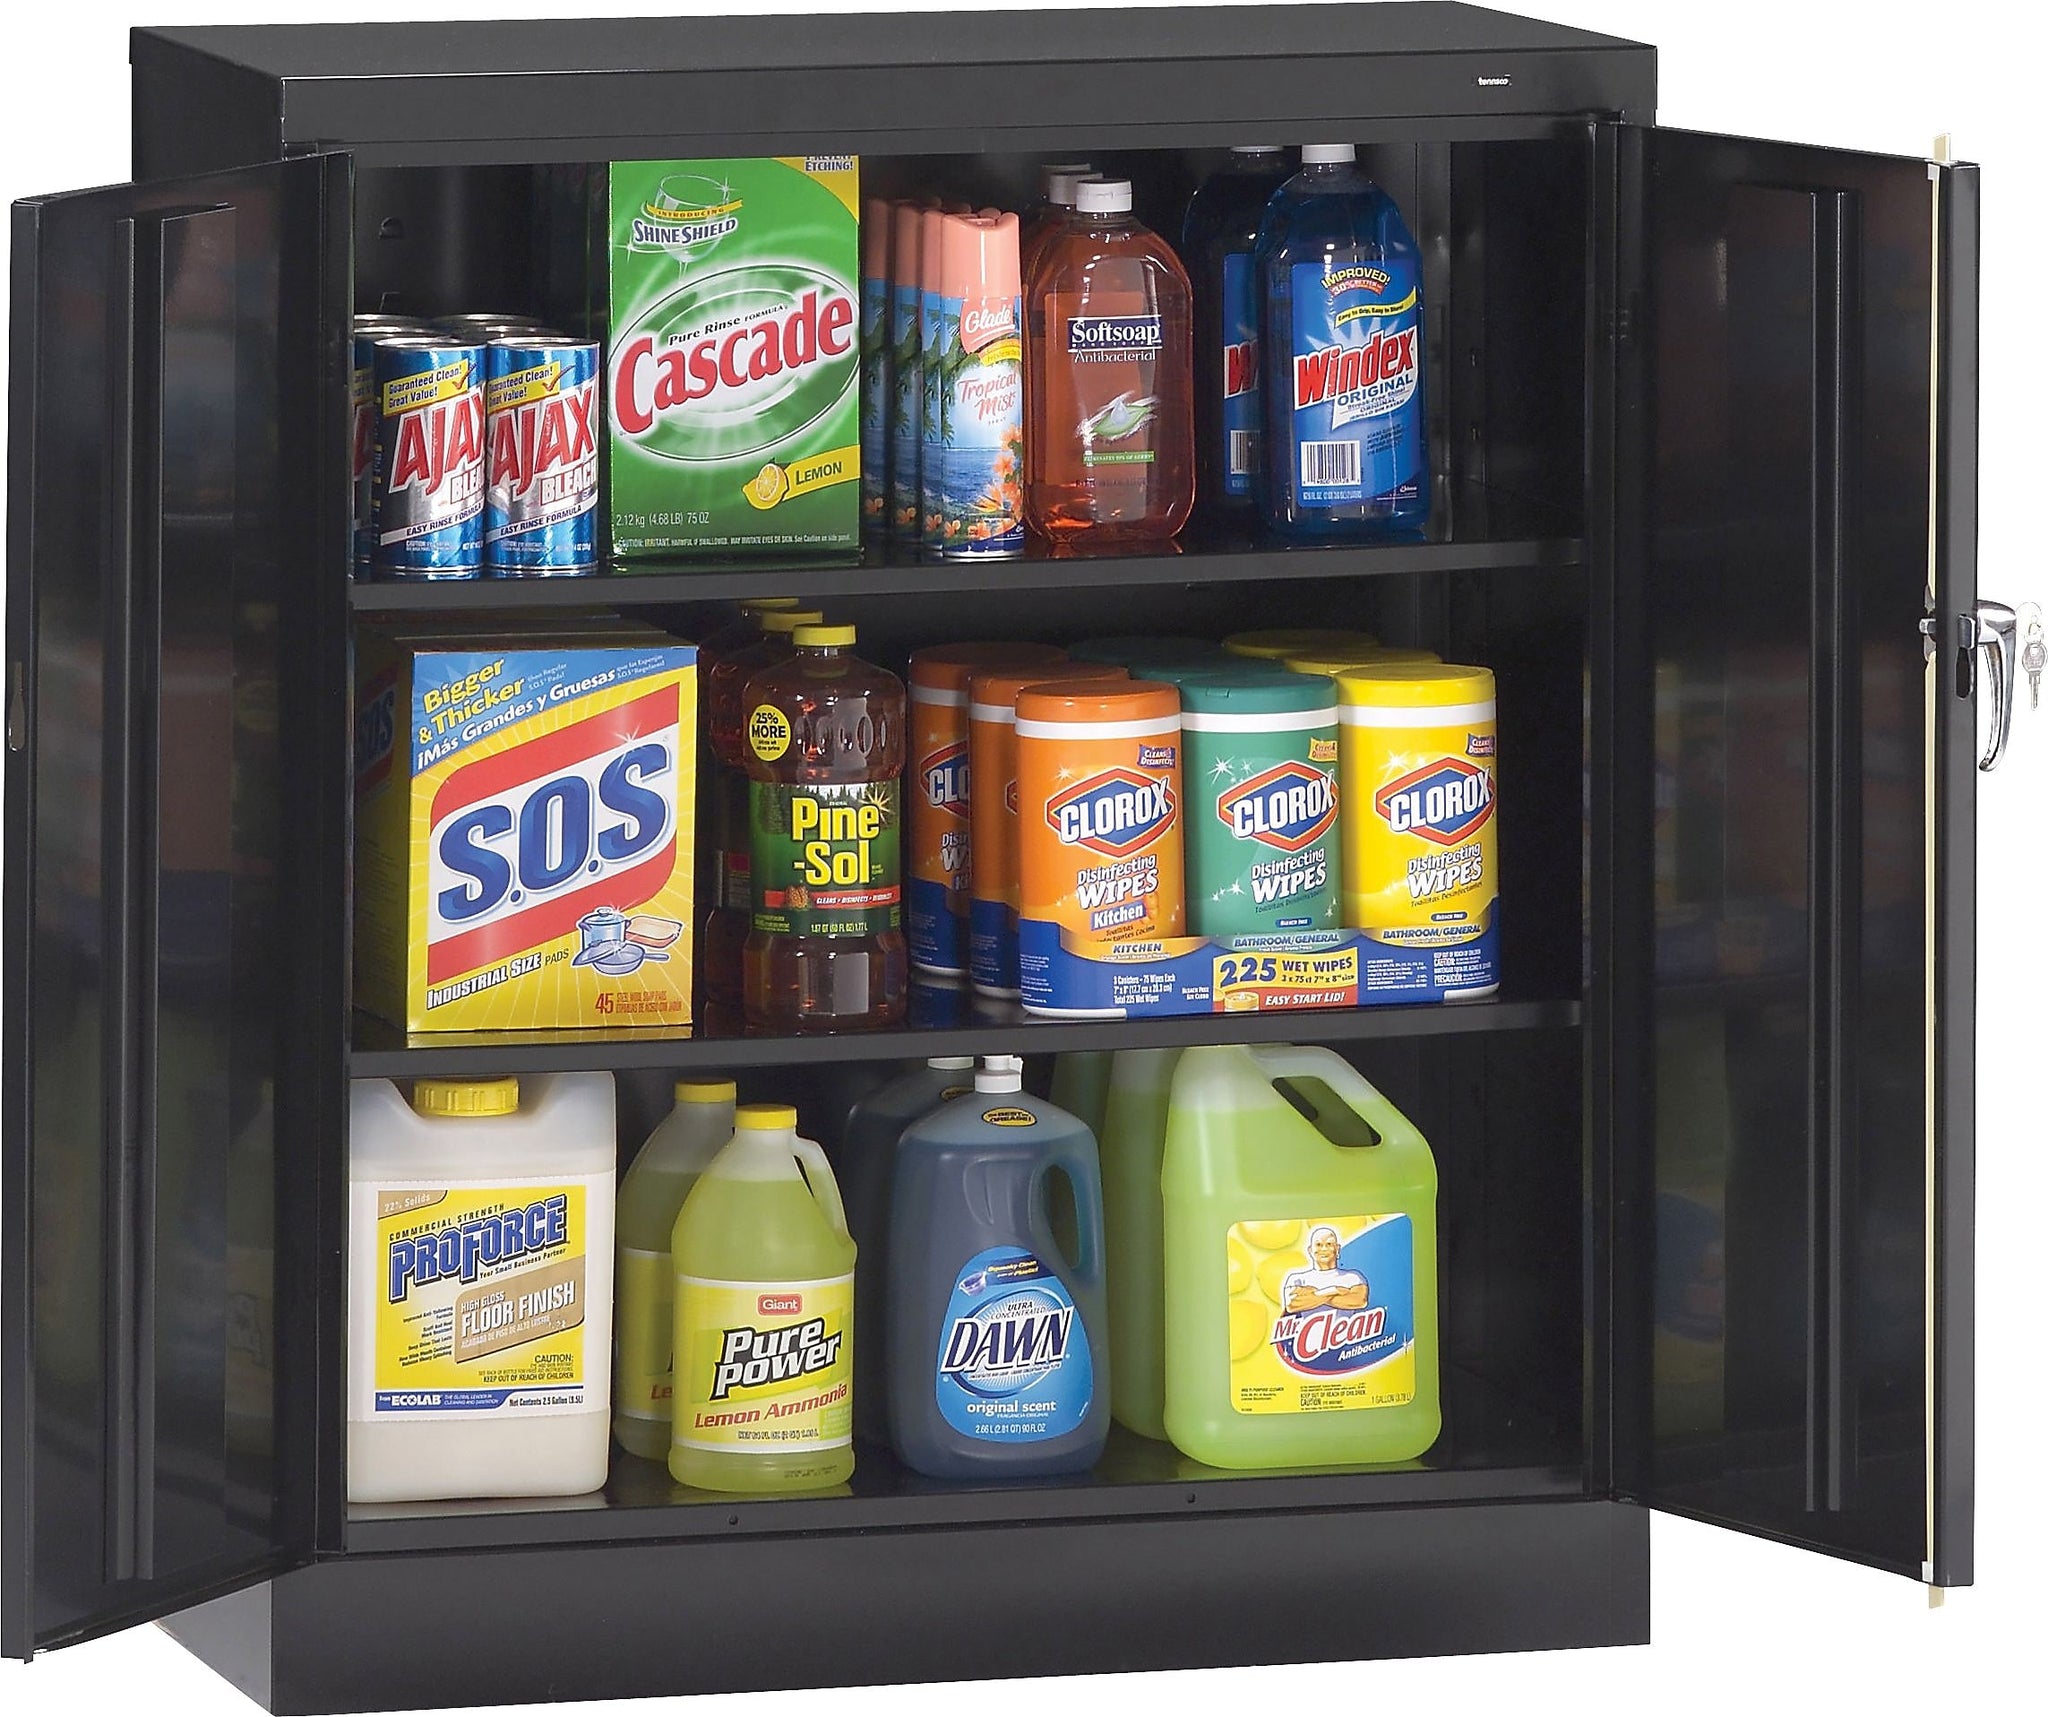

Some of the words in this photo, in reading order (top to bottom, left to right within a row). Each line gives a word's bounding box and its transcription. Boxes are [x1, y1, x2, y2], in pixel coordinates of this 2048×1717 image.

[805, 160, 854, 172] ETCHING!
[657, 206, 726, 218] INTRODUCING
[1321, 267, 1391, 288] IMPROVED!
[669, 329, 701, 346] Pure
[704, 315, 741, 335] Rinse
[744, 305, 785, 323] FORMULA
[965, 305, 1011, 334] Glade
[1071, 321, 1160, 346] Softsoap
[615, 290, 855, 434] Cascade
[1075, 348, 1156, 363] Antibacterial
[1297, 328, 1415, 407] Windex
[389, 372, 434, 395] Guaranteed
[436, 365, 462, 381] Clean!
[524, 366, 553, 384] Clean!
[957, 368, 1017, 403] Tropical
[389, 394, 408, 408] Great
[410, 386, 437, 403] Value!
[503, 388, 527, 403] Value!
[1337, 373, 1414, 407] ORIGINAL
[974, 391, 1015, 422] Mist
[491, 386, 596, 496] AJAX
[795, 461, 842, 486] LEMON
[406, 522, 428, 536] EASY
[429, 516, 453, 530] RINSE
[500, 523, 518, 536] EASY
[519, 517, 544, 531] RINSE
[545, 505, 582, 524] FORMULA
[616, 513, 634, 527] 2.12
[635, 514, 645, 528] kg
[648, 512, 669, 527] (4.68
[670, 511, 684, 526] LB)
[687, 511, 697, 525] 75
[698, 511, 710, 524] OZ
[423, 656, 507, 714] Bigger
[417, 738, 459, 770] ¡Más
[462, 702, 534, 742] Grandes
[536, 692, 548, 711] y
[549, 668, 616, 702] Gruesas
[418, 726, 433, 745] &
[431, 675, 526, 735] Thicker
[755, 712, 779, 725] 25%
[751, 724, 787, 738] MORE
[1060, 777, 1169, 843] CLOROX
[1232, 768, 1335, 839] CLOROX
[1389, 768, 1491, 832] CLOROX
[437, 742, 668, 921] S.O.S
[791, 796, 880, 841] Pine
[1077, 853, 1156, 886] Disinfecting
[1251, 848, 1325, 880] Disinfecting
[1407, 843, 1482, 873] Disinfecting
[1075, 868, 1158, 910] WIPES
[1250, 863, 1327, 904] WIPES
[1406, 857, 1483, 899] WIPES
[816, 897, 837, 905] CLEANS
[1093, 903, 1144, 928] Kitchen
[1233, 933, 1340, 948] BATHROOM/GENERAL
[1382, 924, 1482, 939] BATHROOM/GENERAL
[1113, 943, 1162, 953] KITCHEN
[427, 964, 508, 1010] INDUSTRIAL
[510, 952, 542, 978] SIZE
[545, 948, 570, 967] PADS
[1219, 957, 1277, 988] 225
[1282, 960, 1316, 972] WET
[1320, 956, 1353, 972] WIPES
[1281, 974, 1288, 983] 3
[1294, 973, 1305, 983] 75
[1342, 973, 1355, 982] size
[595, 992, 614, 1014] 45
[1265, 993, 1291, 1006] EASY
[1292, 992, 1324, 1004] START
[1324, 991, 1345, 1004] LID!
[404, 1193, 431, 1208] Solids
[389, 1217, 452, 1241] COMMERCIAL
[457, 1203, 505, 1224] STRENGTH
[479, 1271, 494, 1280] Your
[495, 1263, 513, 1275] Small
[514, 1256, 542, 1270] Business
[543, 1247, 567, 1262] Partner
[461, 1298, 480, 1313] HIGH
[481, 1290, 506, 1309] GLOSS
[461, 1302, 514, 1338] FLOOR
[518, 1280, 576, 1320] FINISH
[762, 1299, 799, 1312] Giant
[990, 1306, 1047, 1320] CONCENTRATED
[1007, 1301, 1033, 1312] ULTRA
[723, 1319, 824, 1365] Pure
[943, 1309, 1072, 1372] DAWN
[1273, 1316, 1300, 1340] Mr.
[1297, 1309, 1384, 1359] Clean
[534, 1354, 574, 1364] CAUTION:
[1338, 1333, 1397, 1362] Antibacterial
[483, 1375, 498, 1383] KEEP
[498, 1374, 510, 1382] OUT
[510, 1374, 518, 1382] OF
[519, 1373, 537, 1381] REACH
[538, 1373, 546, 1381] OF
[546, 1371, 575, 1380] CHILDREN
[391, 1394, 442, 1407] ECOLAB
[509, 1398, 519, 1407] Net
[519, 1397, 542, 1407] Contents
[542, 1396, 551, 1406] 2.5
[551, 1396, 568, 1405] Gallon
[694, 1407, 760, 1429] Lemon
[764, 1382, 849, 1421] Ammonia
[966, 1399, 1019, 1417] original
[1022, 1400, 1057, 1412] scent
[975, 1424, 989, 1434] 2.66
[989, 1424, 994, 1433] L
[1022, 1424, 1030, 1433] 90
[1030, 1423, 1038, 1433] FL
[1038, 1423, 1047, 1433] OZ
